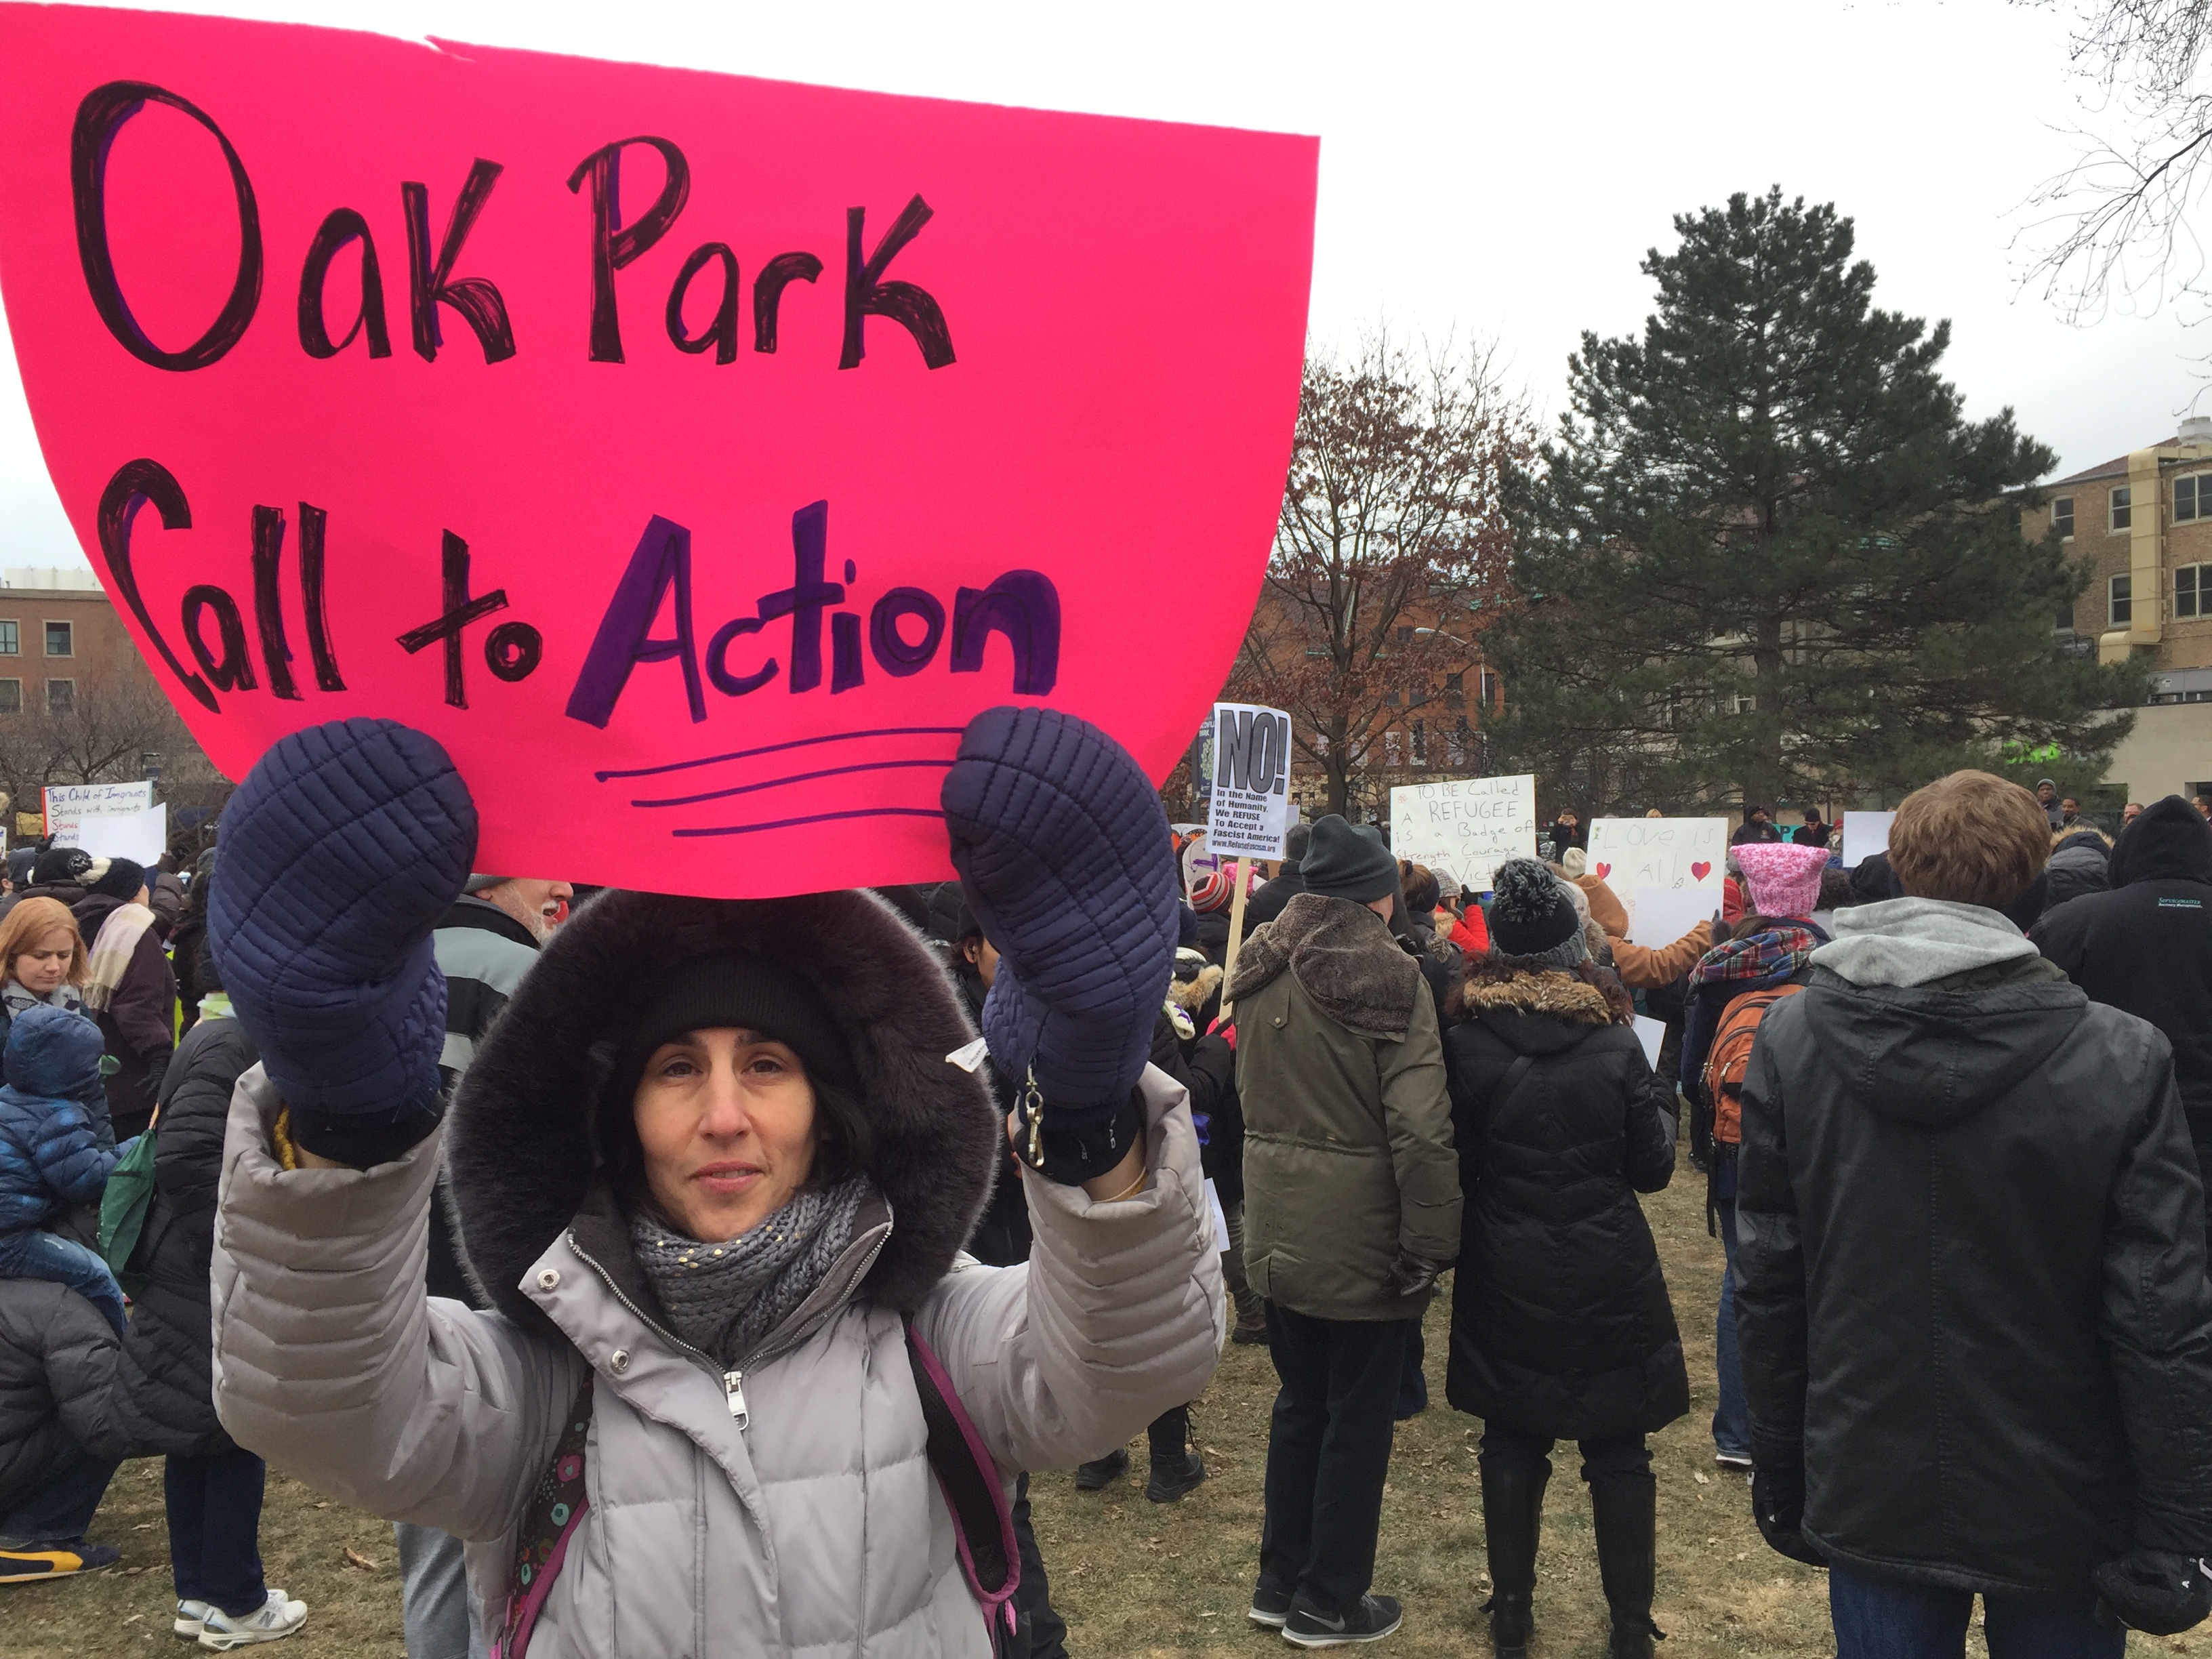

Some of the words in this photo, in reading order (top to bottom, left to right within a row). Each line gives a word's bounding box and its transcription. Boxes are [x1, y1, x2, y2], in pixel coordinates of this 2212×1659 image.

[70, 79, 516, 372] Oak
[567, 136, 956, 370] Park
[97, 458, 348, 714] Call
[396, 529, 543, 710] to
[565, 499, 1061, 729] Action
[1218, 709, 1288, 795] NO!
[45, 787, 65, 803] This
[68, 787, 90, 802] Child
[93, 789, 103, 800] of
[1216, 789, 1225, 797] In
[1229, 790, 1243, 799] the
[1246, 792, 1267, 802] Name
[1415, 785, 1435, 800] TO
[1441, 783, 1459, 797] BE
[1468, 780, 1519, 796] Called
[51, 804, 82, 817] Stands
[86, 804, 102, 814] with
[1215, 808, 1230, 817] We
[1233, 811, 1261, 821] REFUSE
[1228, 800, 1268, 813] Humanity,
[1401, 813, 1413, 825] A
[1429, 800, 1519, 823] REFUGEE
[52, 819, 78, 831] Stands
[1214, 819, 1225, 827] To
[1227, 821, 1257, 831] Accept
[1458, 822, 1509, 844] Badge
[1515, 819, 1534, 833] of
[53, 832, 79, 842] Stands
[1213, 829, 1245, 839] Fascist
[1247, 833, 1280, 843] America!
[1603, 823, 1674, 849] Love
[1396, 849, 1451, 866] Strength
[1637, 853, 1678, 882] All
